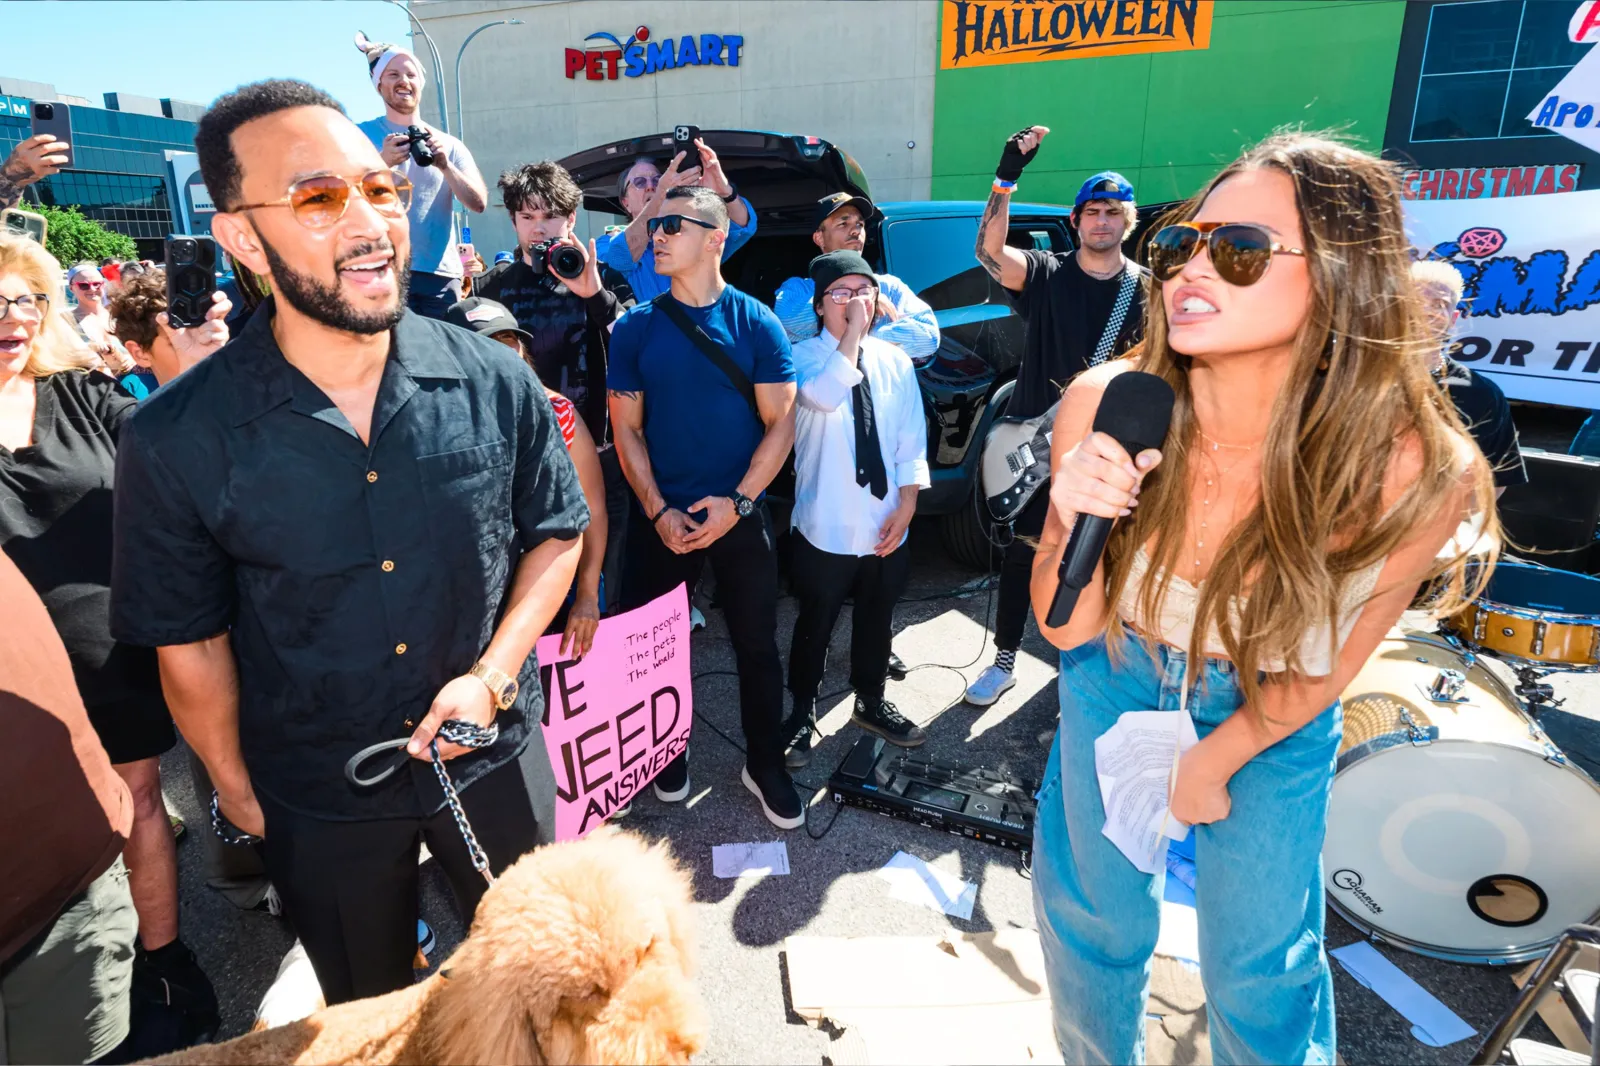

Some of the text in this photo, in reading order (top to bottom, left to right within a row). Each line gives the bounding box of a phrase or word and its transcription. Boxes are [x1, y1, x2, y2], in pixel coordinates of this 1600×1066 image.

[952, 0, 1199, 65] HALLOWEEN
[1535, 95, 1600, 128] APO
[1403, 166, 1578, 200] CHRISTMAS
[625, 608, 682, 646] The people
[627, 634, 676, 665] The pets
[626, 668, 648, 683] The
[577, 727, 690, 835] ANSWERS
[1343, 876, 1384, 914] AQUARIAN
